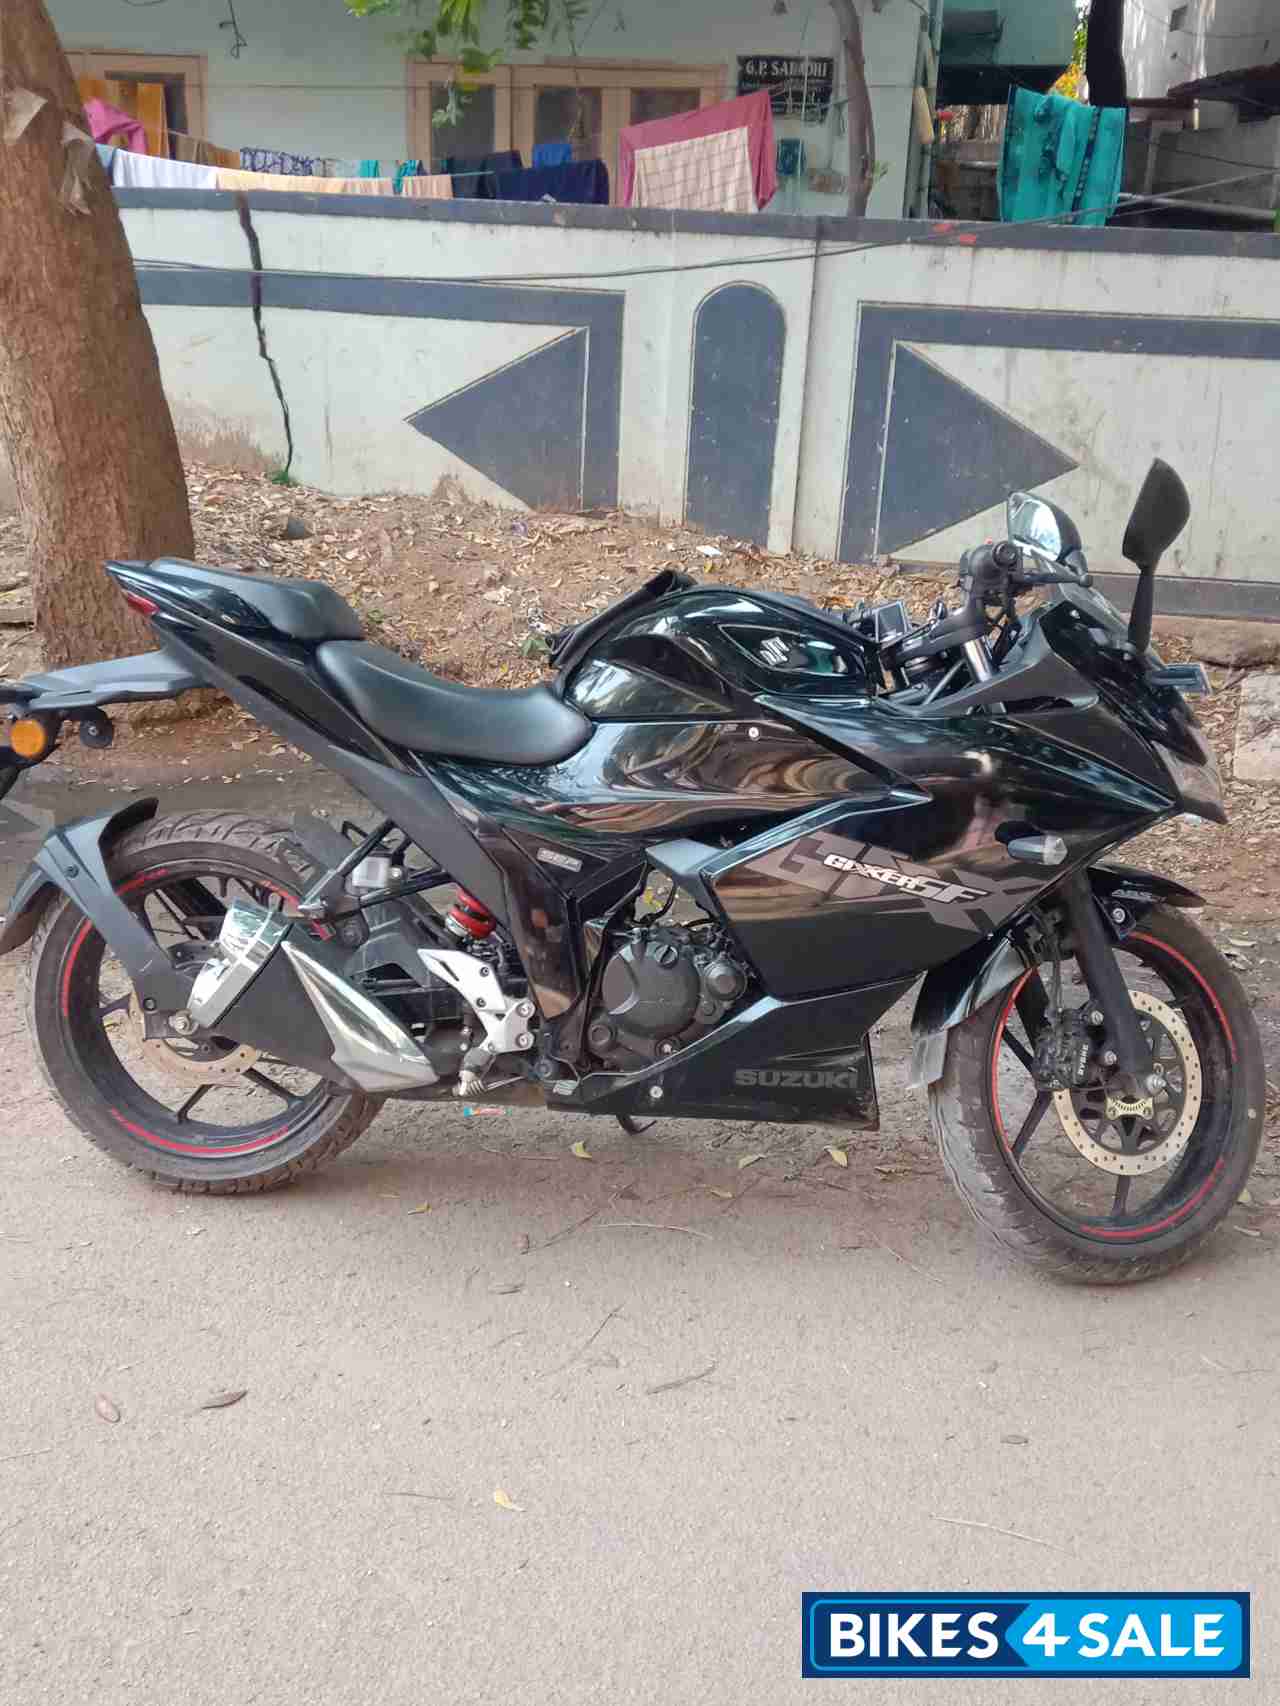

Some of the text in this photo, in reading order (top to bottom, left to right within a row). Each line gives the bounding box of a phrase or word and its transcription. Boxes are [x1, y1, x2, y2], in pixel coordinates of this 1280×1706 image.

[823, 853, 990, 903] GIXXER SF
[735, 1069, 857, 1088] SUZUKI
